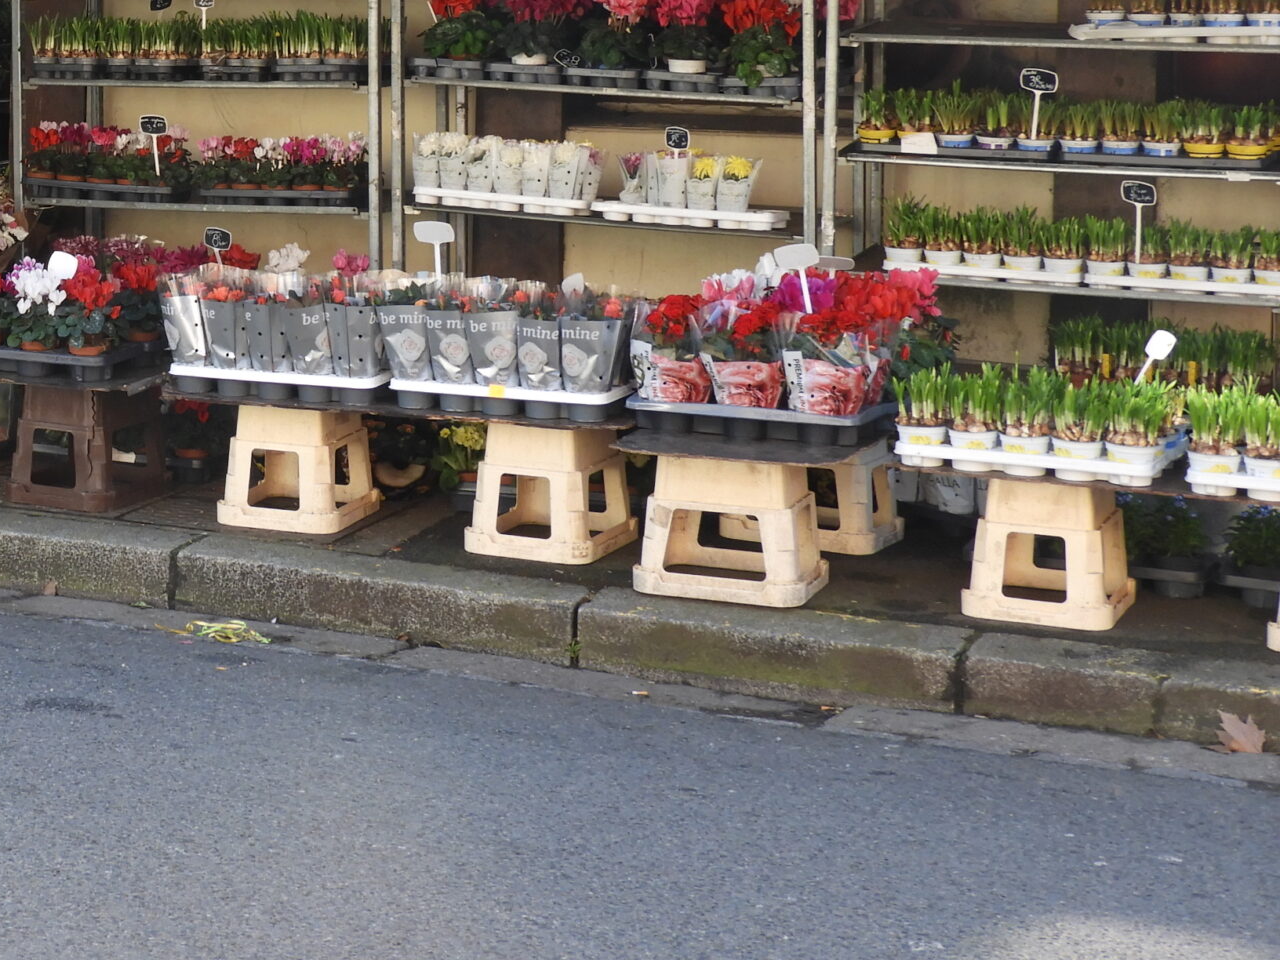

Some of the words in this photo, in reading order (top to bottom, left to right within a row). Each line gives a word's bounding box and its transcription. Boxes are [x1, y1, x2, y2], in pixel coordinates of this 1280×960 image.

[302, 313, 320, 326] be
[380, 312, 396, 325] be
[426, 316, 442, 329] be
[469, 320, 487, 333] be
[522, 326, 559, 340] mine
[561, 326, 600, 340] mine
